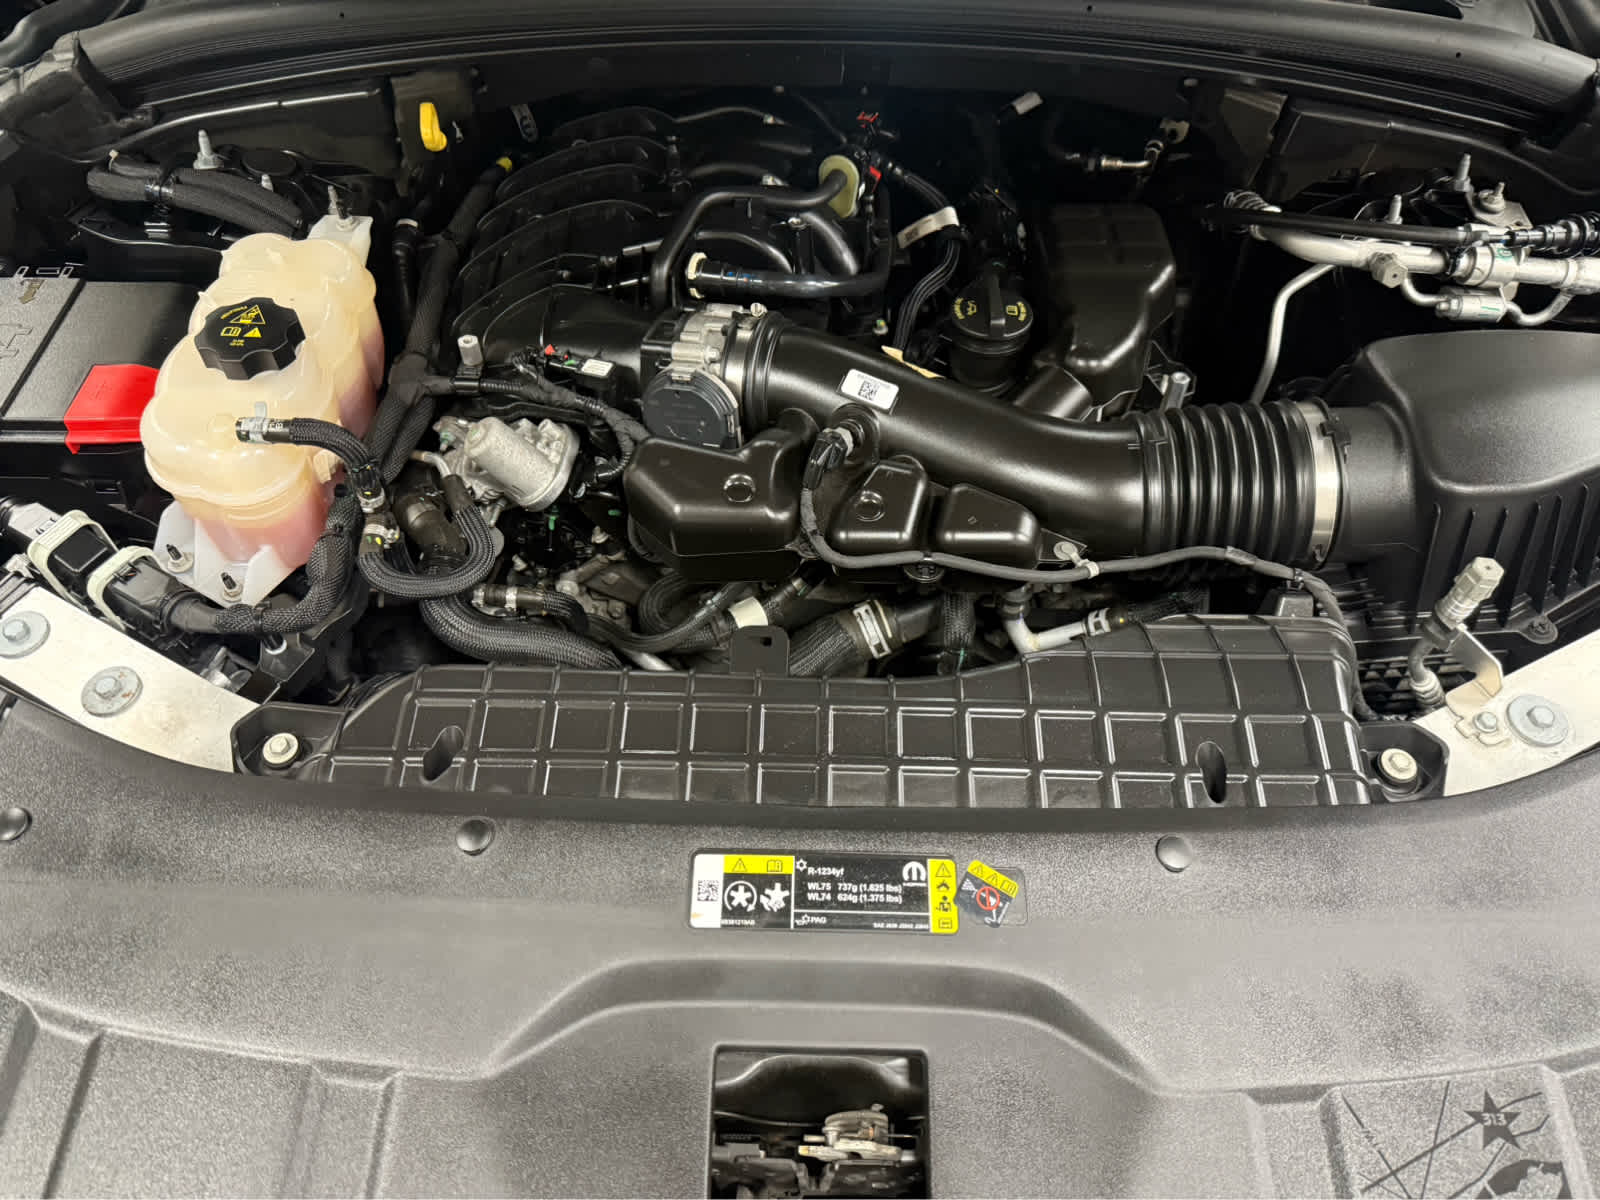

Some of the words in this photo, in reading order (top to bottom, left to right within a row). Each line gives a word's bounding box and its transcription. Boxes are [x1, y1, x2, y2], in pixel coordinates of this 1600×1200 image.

[807, 867, 845, 878] R-1234yf
[807, 882, 832, 891] WL75
[837, 882, 858, 893] 737g
[886, 884, 902, 894] lbs)
[807, 892, 832, 901] WL74
[837, 893, 858, 904] 624g
[886, 894, 902, 905] lbs)
[1481, 1113, 1507, 1126] 313
